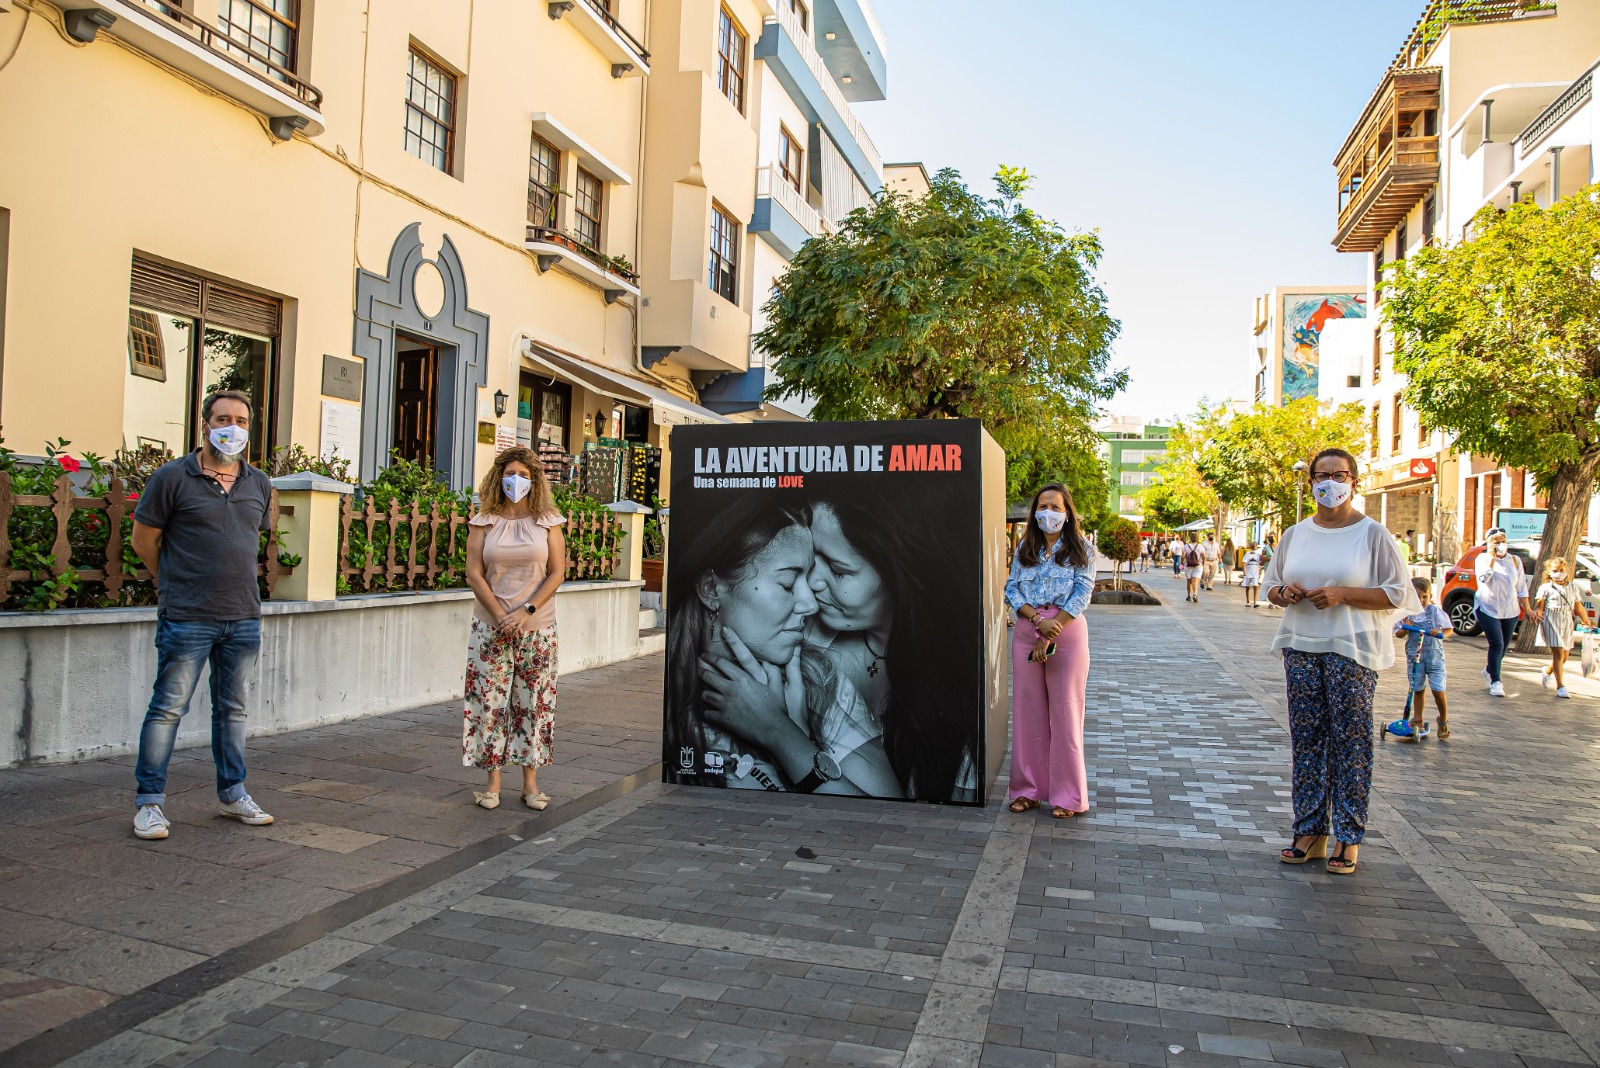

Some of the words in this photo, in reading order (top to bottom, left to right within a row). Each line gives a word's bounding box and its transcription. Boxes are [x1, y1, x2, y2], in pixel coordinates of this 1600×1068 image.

[694, 447, 721, 474] LA
[725, 445, 848, 474] AVENTURA
[853, 445, 884, 472] DE
[888, 444, 962, 472] AMAR
[693, 476, 715, 488] Una
[716, 477, 761, 489] semana
[762, 475, 777, 488] de
[778, 475, 804, 488] LOVE
